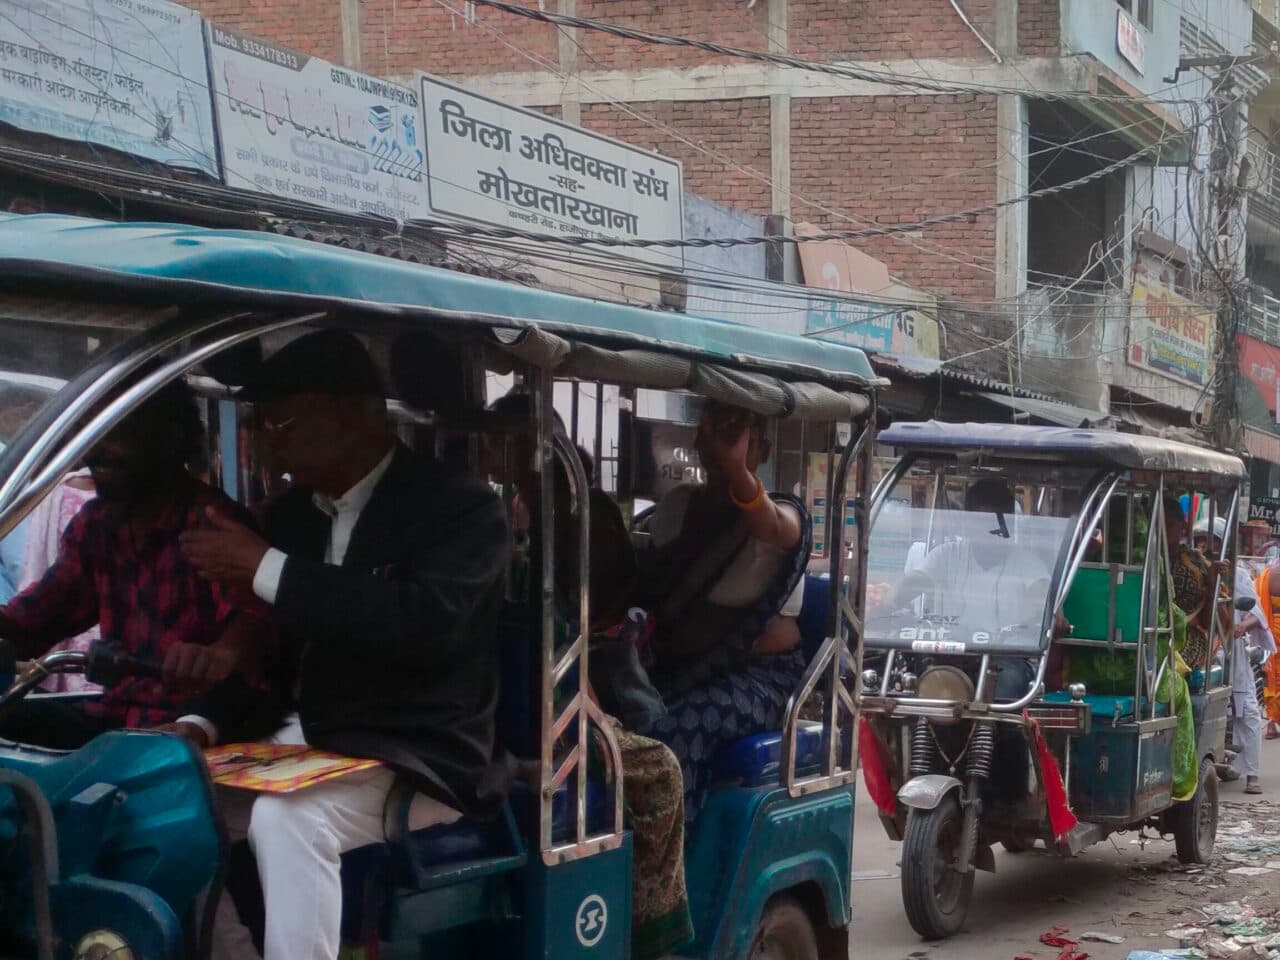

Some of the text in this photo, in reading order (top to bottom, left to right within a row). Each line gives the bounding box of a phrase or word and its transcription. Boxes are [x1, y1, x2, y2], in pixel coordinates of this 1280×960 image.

[214, 29, 239, 49] Mob.
[439, 99, 512, 153] जिला
[518, 133, 627, 188] अधिवक्ता
[477, 166, 639, 236] मोखतारखाना
